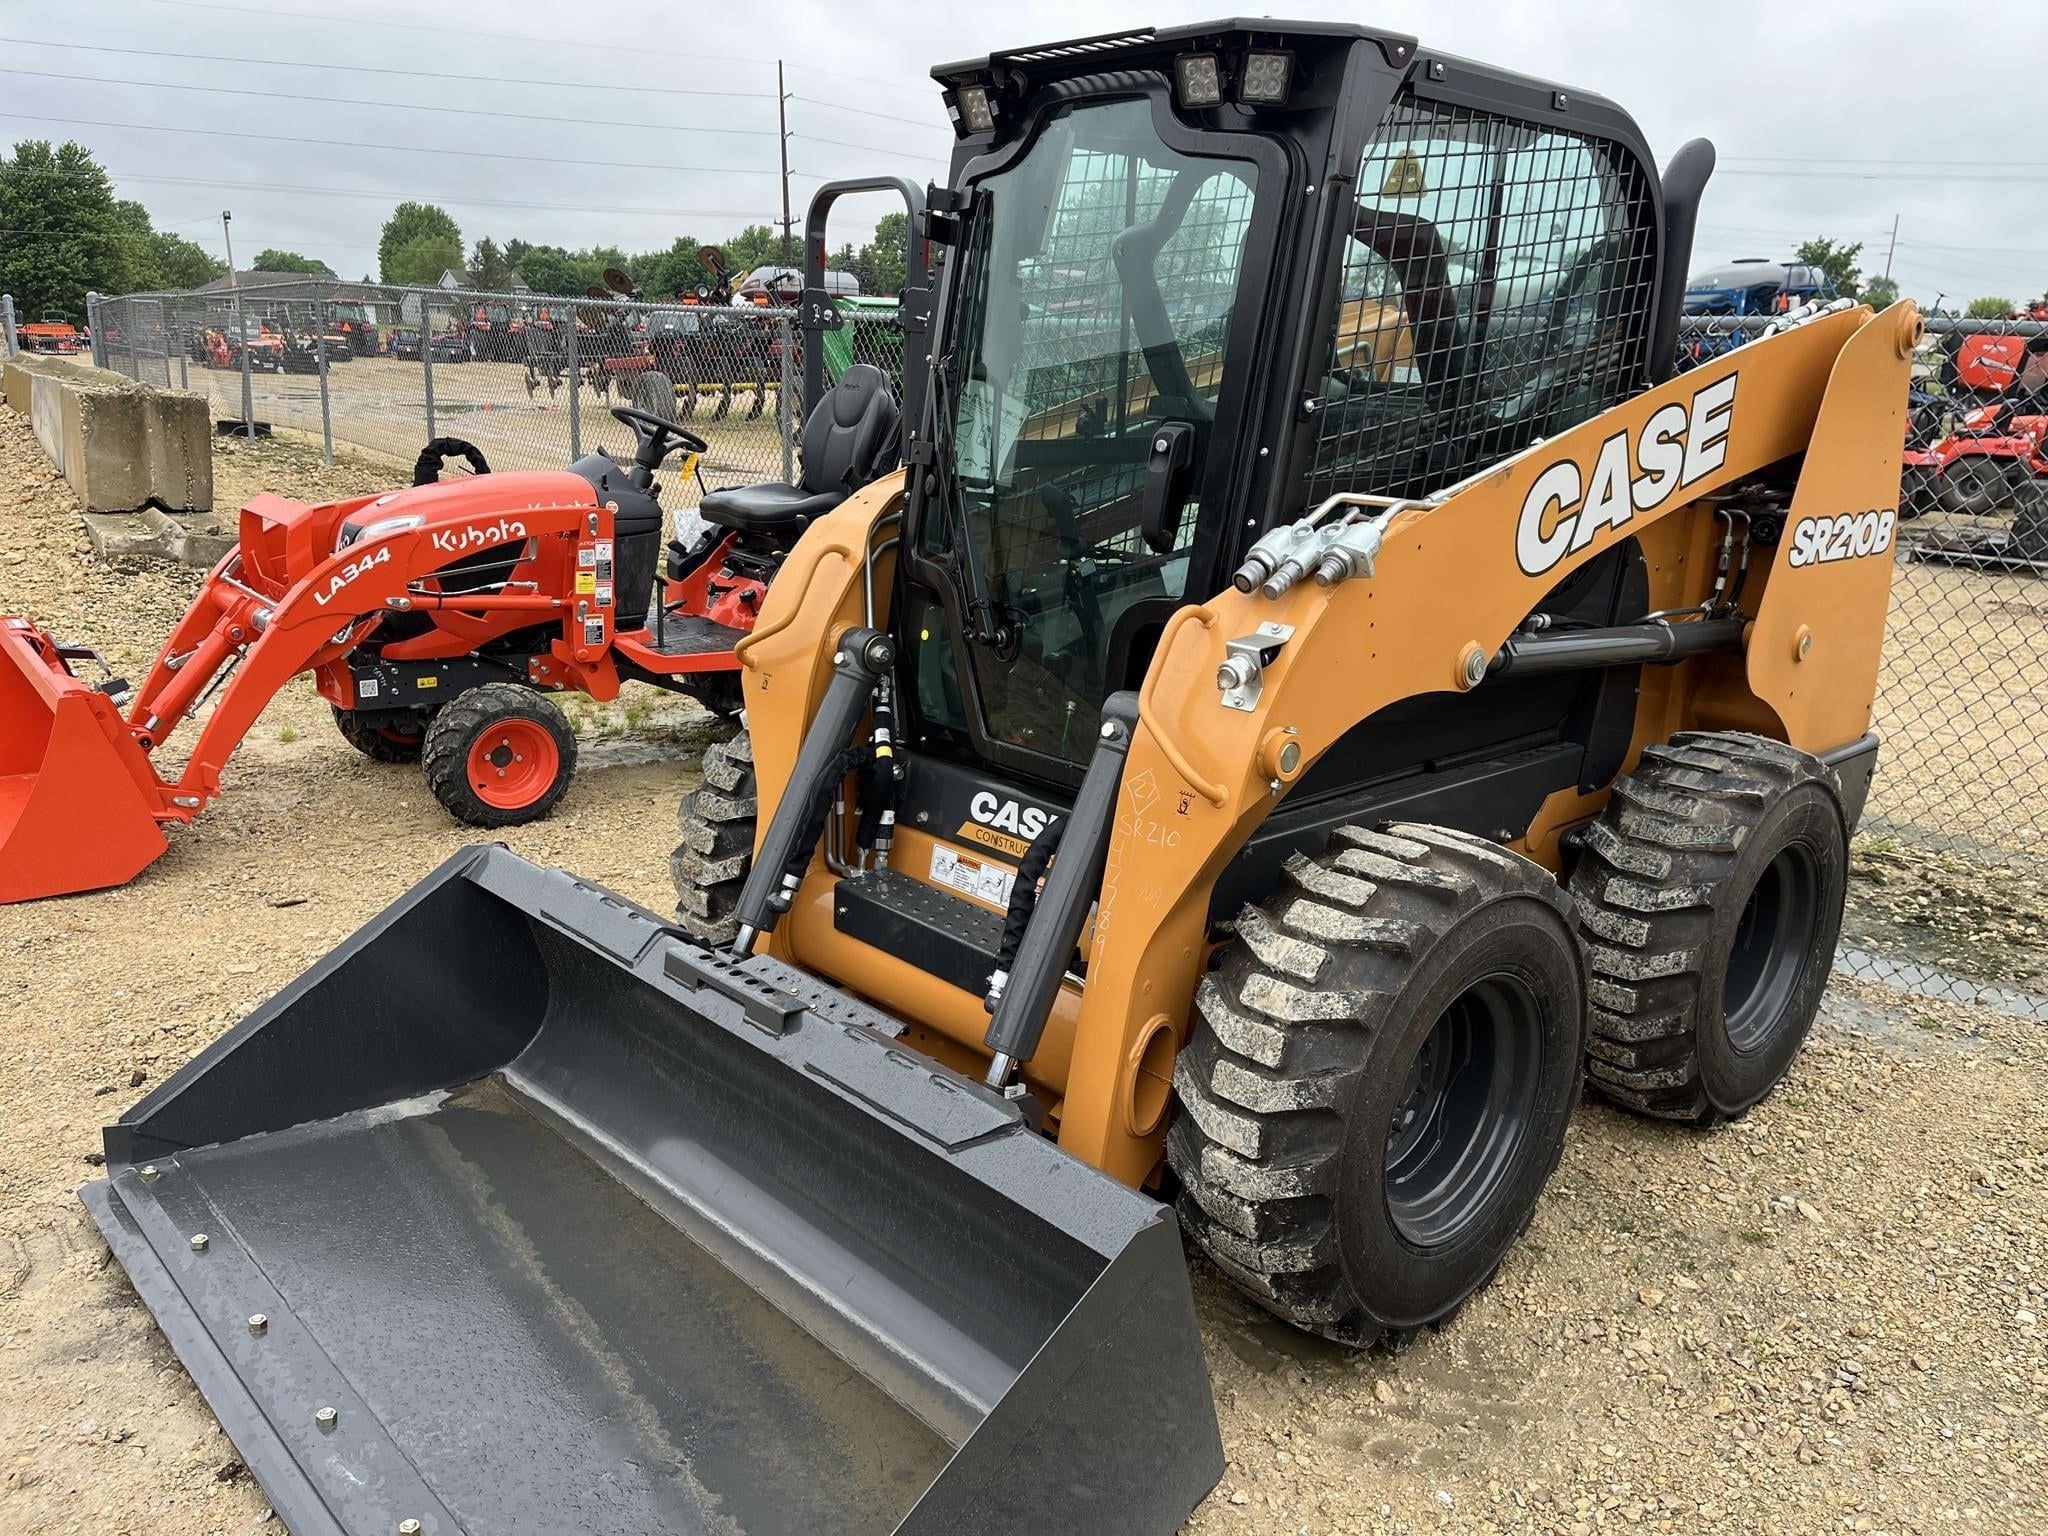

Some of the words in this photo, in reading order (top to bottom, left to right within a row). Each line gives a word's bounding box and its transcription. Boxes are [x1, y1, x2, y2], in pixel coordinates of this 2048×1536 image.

[1516, 370, 1739, 577] CASE
[432, 519, 526, 551] Kubota
[1789, 509, 1896, 568] SR210B
[313, 547, 391, 605] LA344
[970, 791, 1059, 840] CAS
